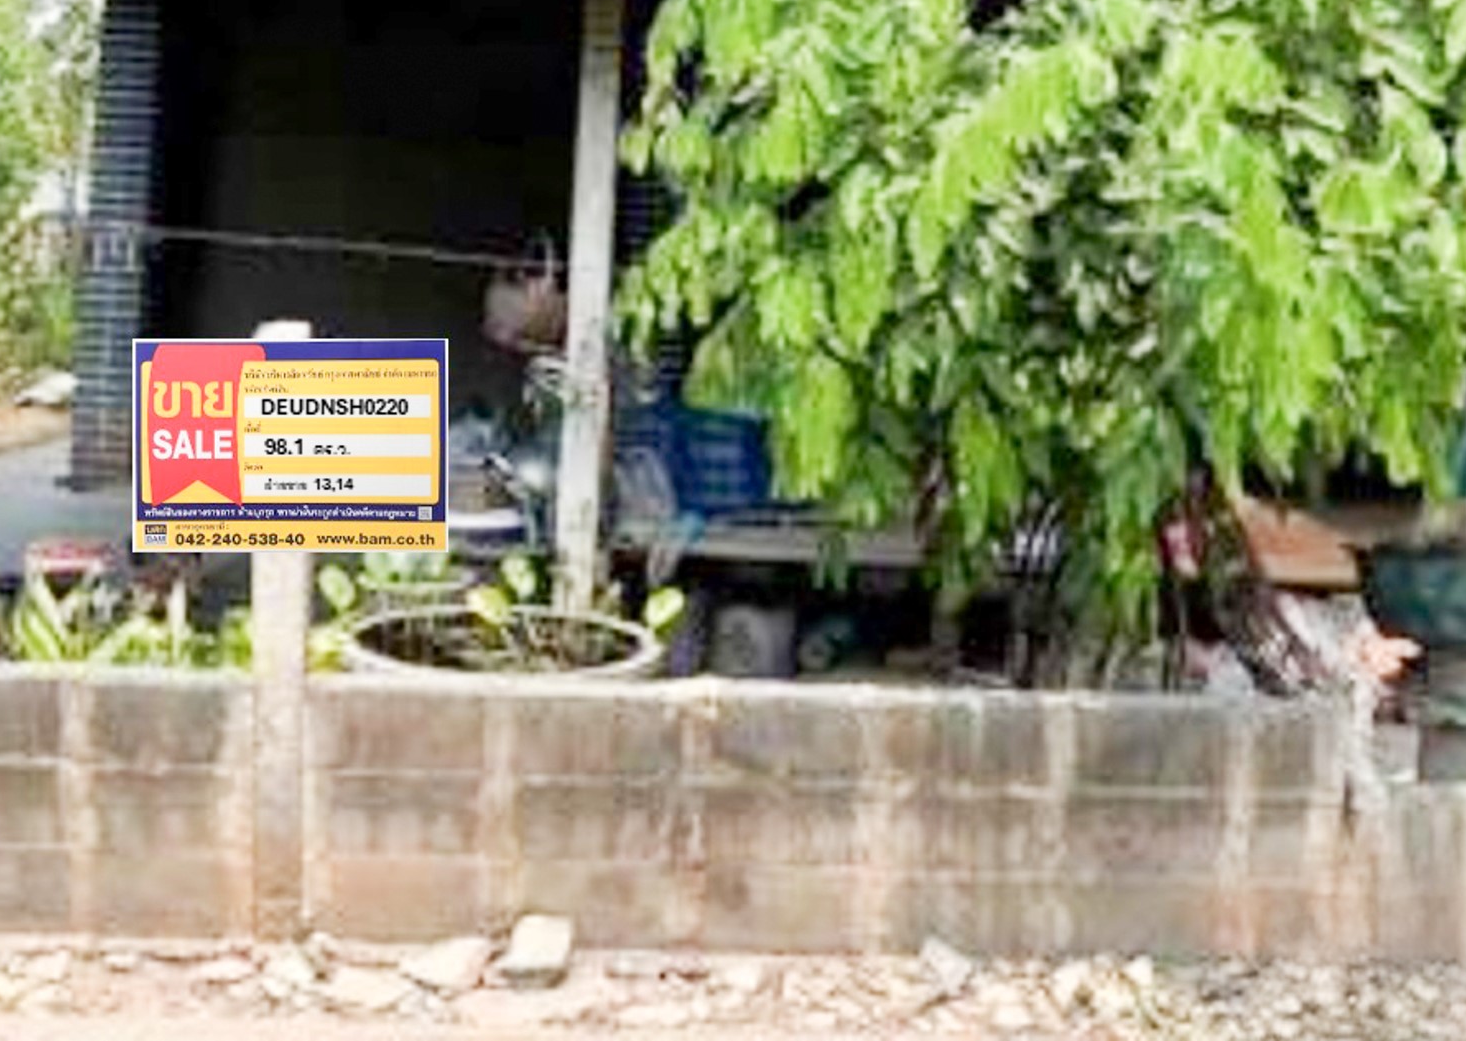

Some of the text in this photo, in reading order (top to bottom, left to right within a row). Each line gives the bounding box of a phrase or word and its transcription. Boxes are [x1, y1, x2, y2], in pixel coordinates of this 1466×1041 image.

[153, 381, 233, 418] ขาย
[261, 398, 409, 415] DEUDNSH0220
[152, 429, 233, 460] SALE
[264, 438, 303, 455] 98.1
[313, 477, 354, 492] 13,14
[175, 533, 435, 546] 042-240-538-40 www.bam.co.th
